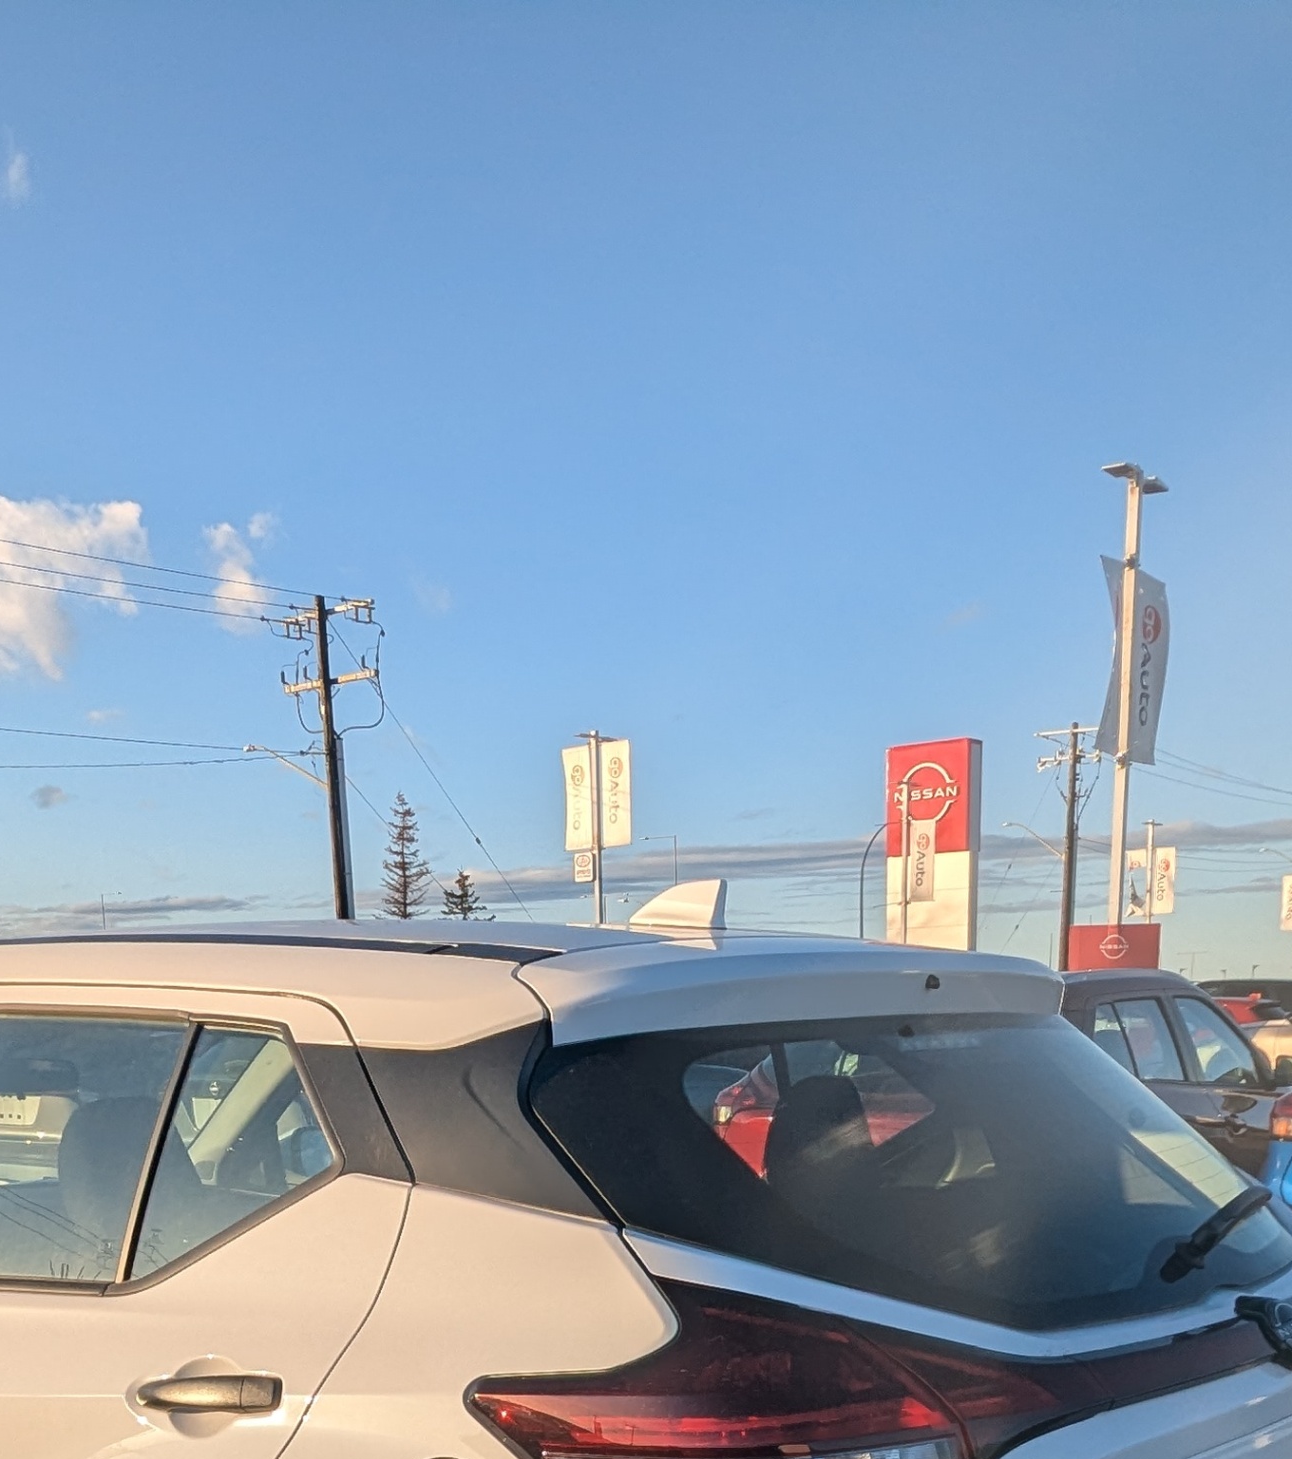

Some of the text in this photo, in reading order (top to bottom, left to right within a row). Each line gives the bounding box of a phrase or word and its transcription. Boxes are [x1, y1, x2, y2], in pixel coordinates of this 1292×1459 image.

[1139, 643, 1151, 726] Auto
[609, 780, 619, 824] Auto
[894, 786, 957, 803] NSSAN
[916, 851, 926, 887] Auto
[1156, 872, 1167, 902] Auto
